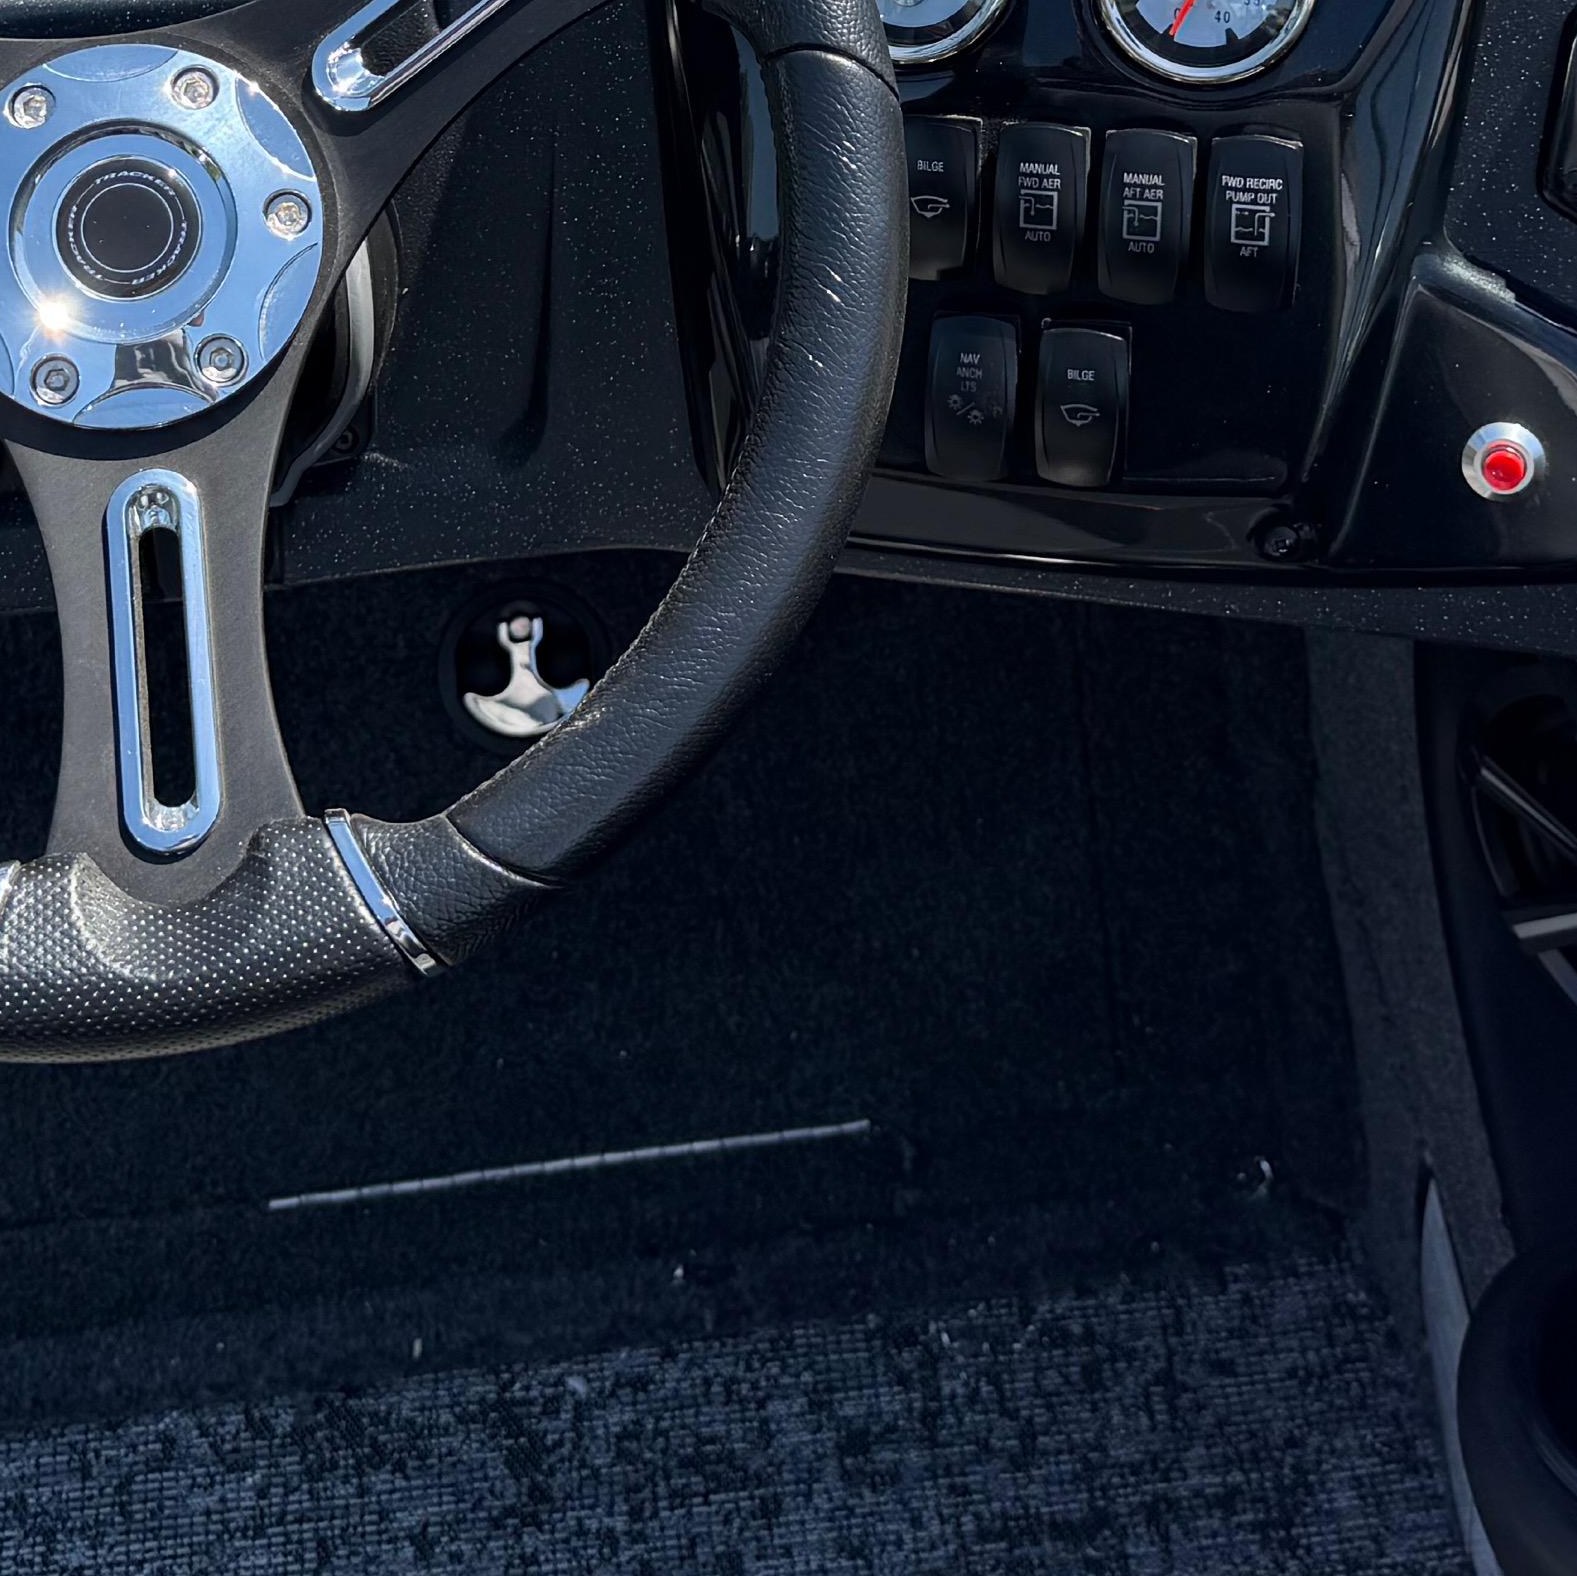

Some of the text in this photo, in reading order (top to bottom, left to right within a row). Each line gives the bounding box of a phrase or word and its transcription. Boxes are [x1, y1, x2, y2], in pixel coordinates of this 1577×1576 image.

[1214, 10, 1231, 24] 40
[917, 159, 944, 173] BILGE
[1019, 162, 1061, 175] MANUAL
[95, 170, 176, 196] TRACKER
[1018, 176, 1061, 190] FWD AER
[1123, 172, 1165, 186] MANUAL
[1222, 175, 1283, 191] FWD RECIRC
[1123, 187, 1164, 200] AFT AER
[1225, 190, 1278, 205] PUMP OUT
[1025, 231, 1051, 242] AUTO
[1128, 241, 1155, 254] AUTO
[1239, 246, 1259, 258] AFT
[960, 352, 981, 365] NAV
[956, 366, 983, 380] ANCH
[1067, 369, 1096, 381] BILGE
[960, 381, 977, 393] LTS
